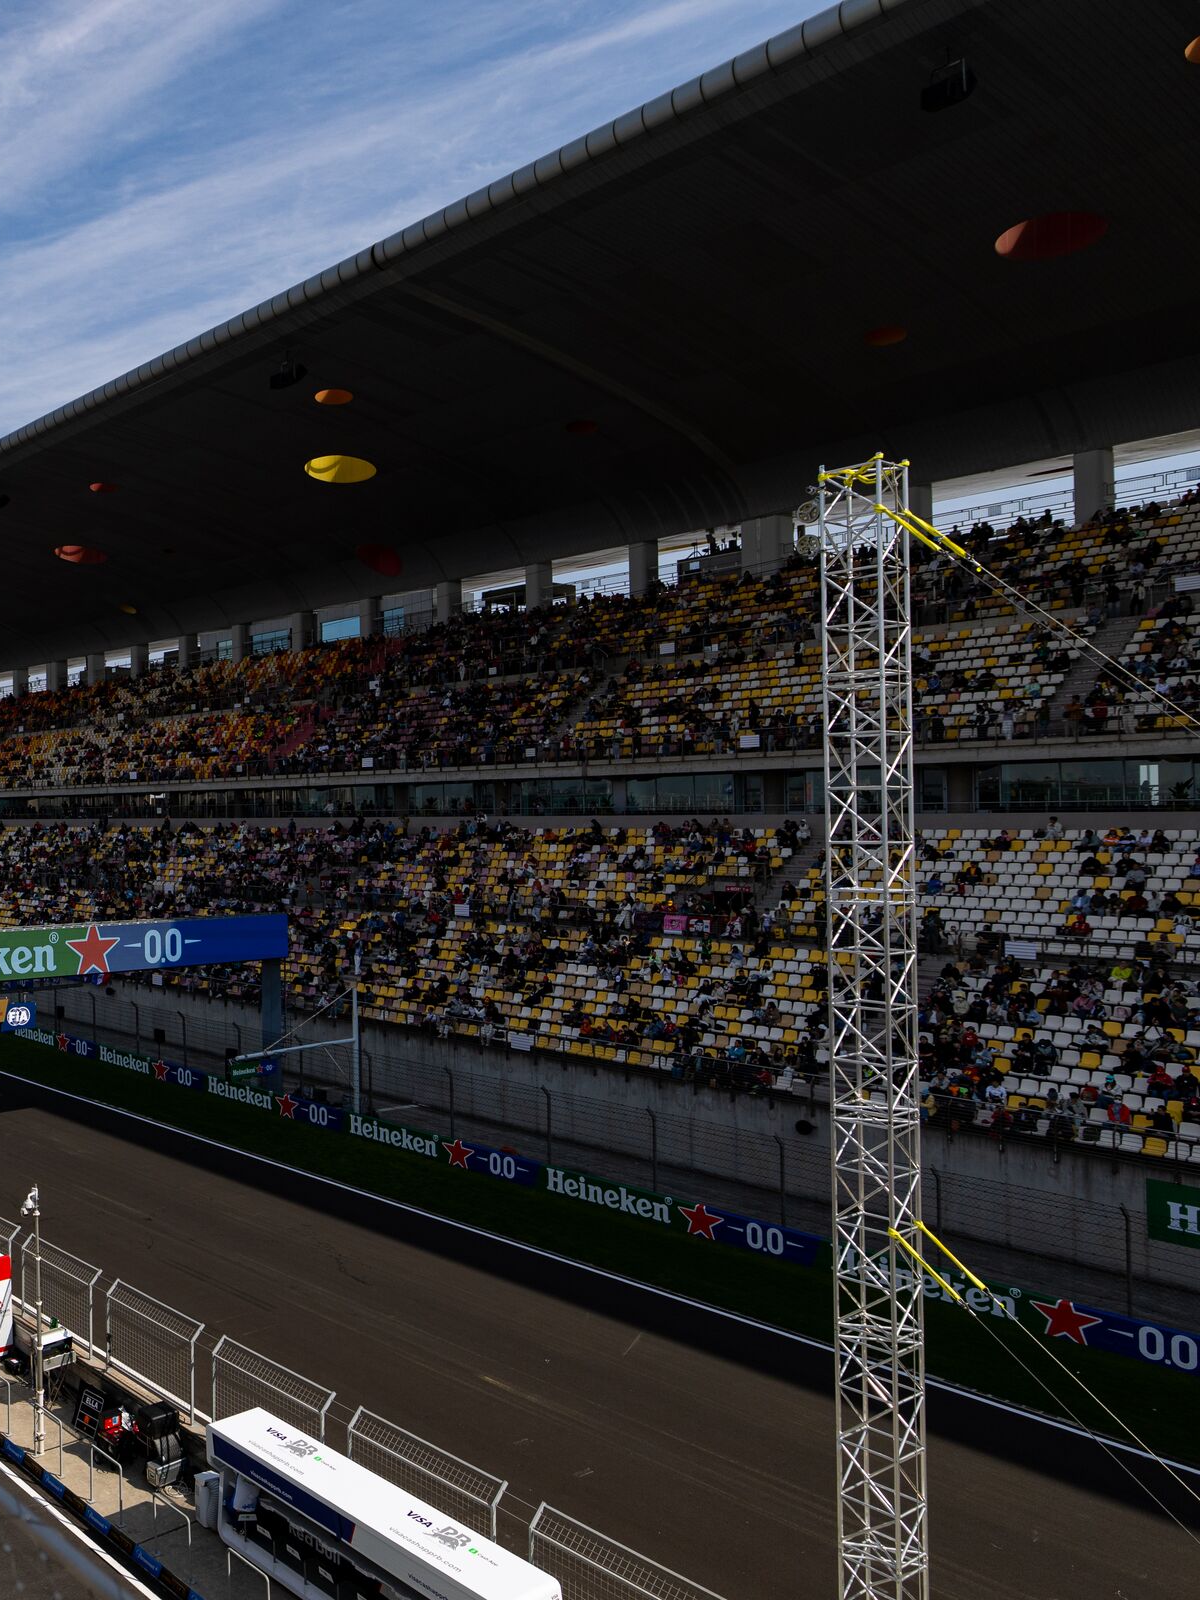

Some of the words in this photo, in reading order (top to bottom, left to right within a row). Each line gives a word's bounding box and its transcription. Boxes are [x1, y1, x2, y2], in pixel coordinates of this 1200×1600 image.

[8, 1009, 30, 1022] FIA
[100, 1045, 150, 1074] Heineken
[208, 1075, 272, 1110] Heineken
[349, 1114, 438, 1158] Heineken
[546, 1168, 672, 1225] Heineken
[266, 1427, 288, 1441] VISA
[406, 1510, 433, 1529] VISA
[389, 1526, 462, 1574] visacashapprb.com
